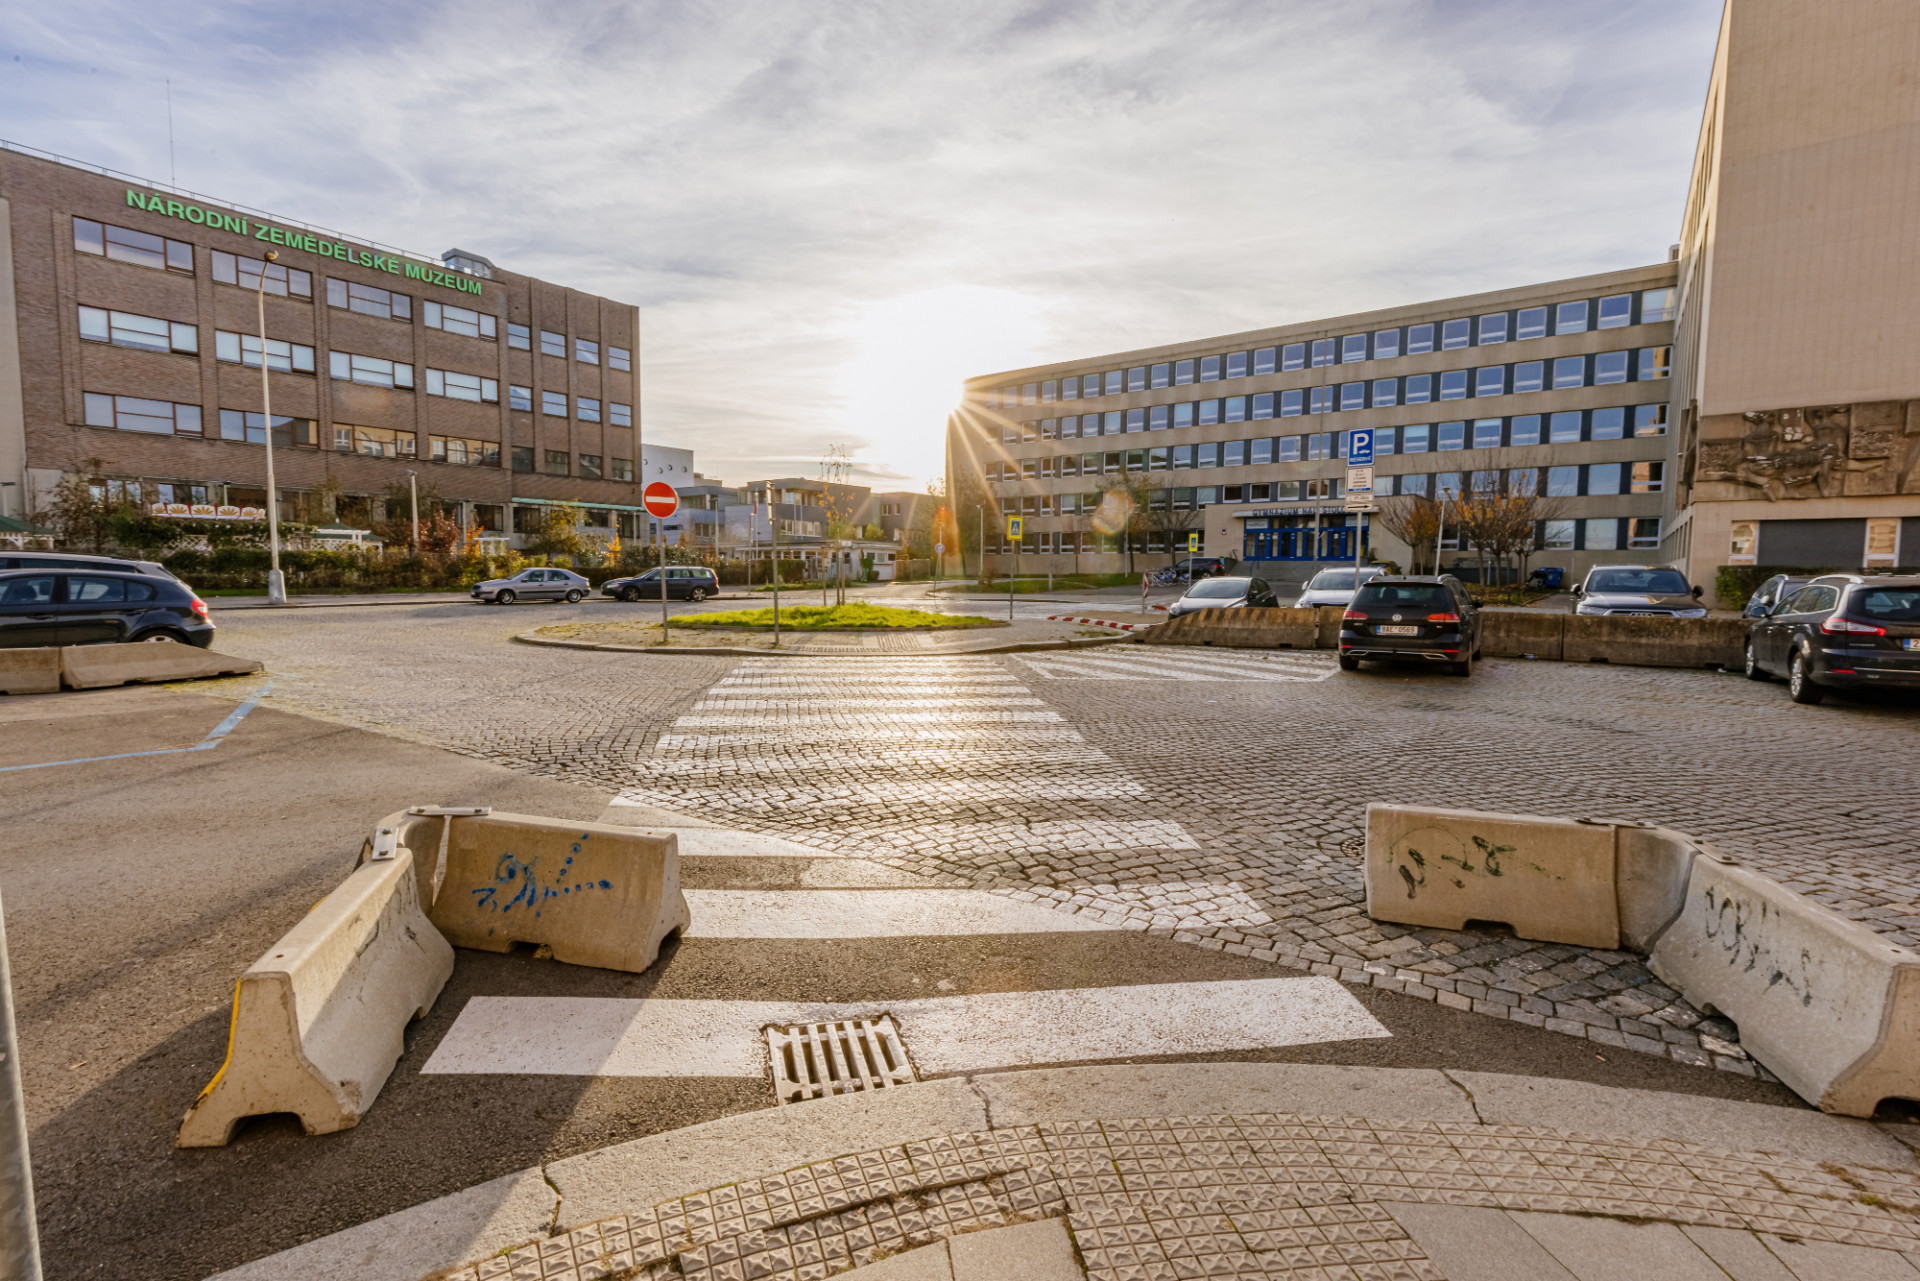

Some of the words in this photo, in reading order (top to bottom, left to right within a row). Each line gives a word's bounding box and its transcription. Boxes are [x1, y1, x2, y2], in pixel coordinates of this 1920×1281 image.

[126, 188, 248, 236] NÁRODNÍ
[254, 223, 400, 275] ZEMĚDĚLSKÉ
[405, 263, 482, 296] MUZEUM
[1353, 433, 1369, 455] P
